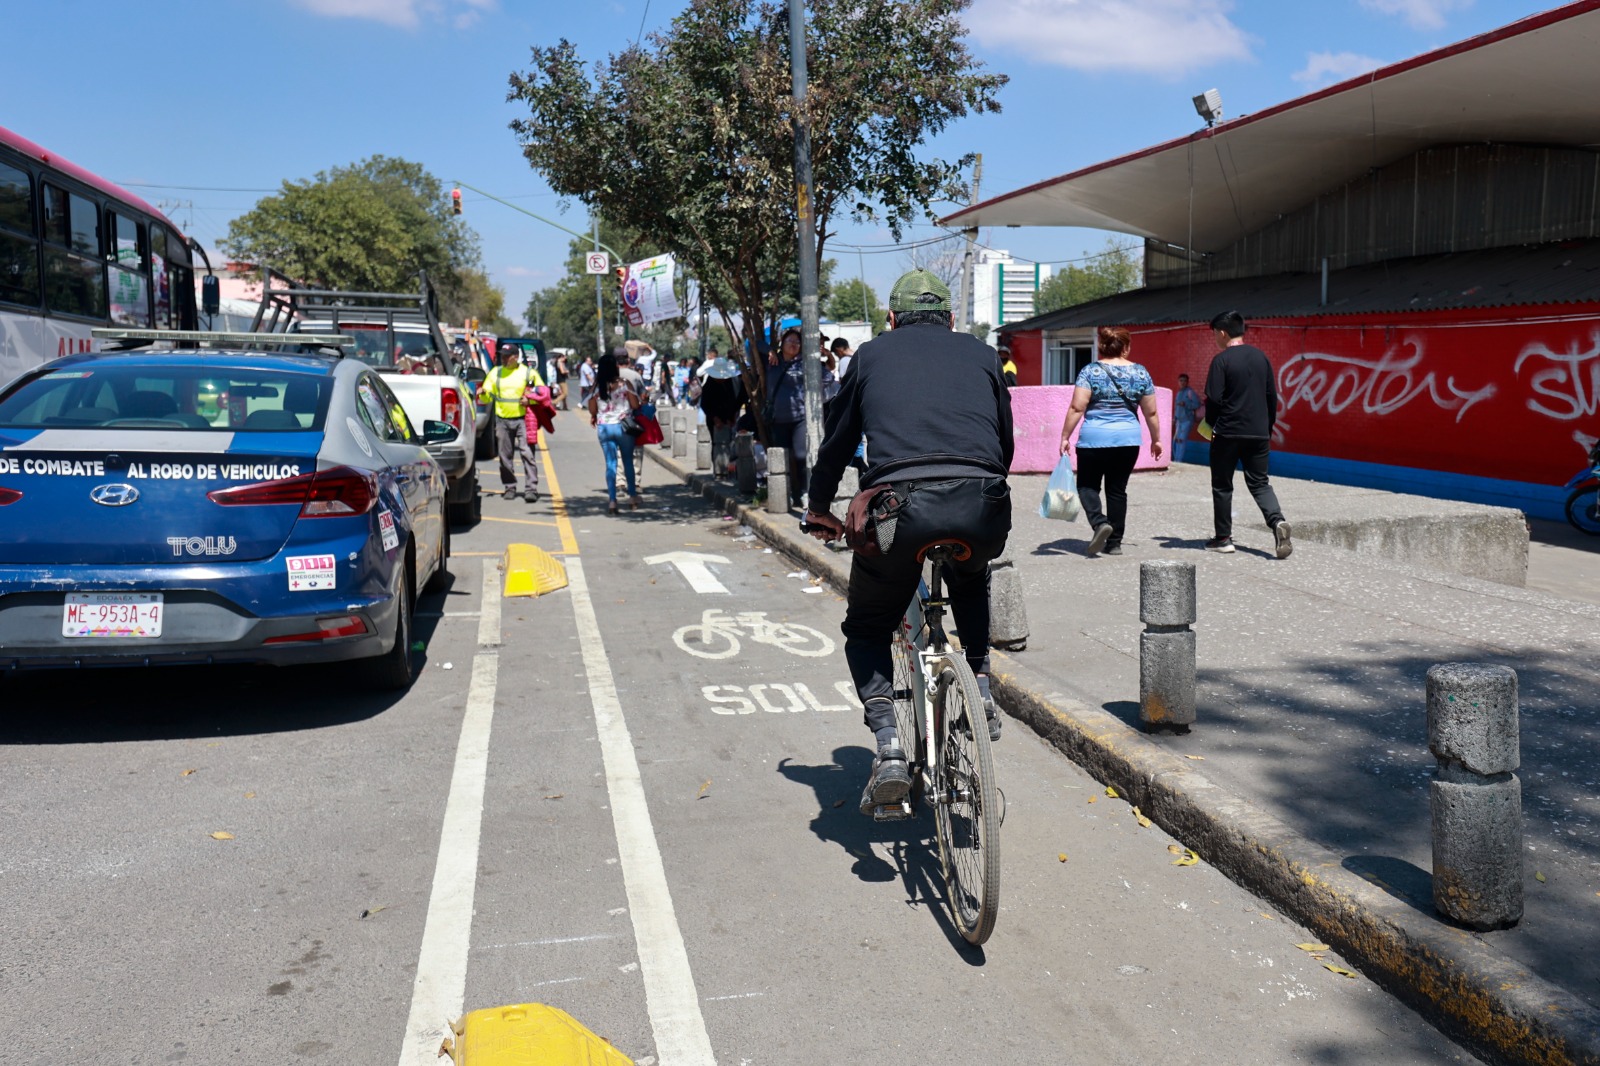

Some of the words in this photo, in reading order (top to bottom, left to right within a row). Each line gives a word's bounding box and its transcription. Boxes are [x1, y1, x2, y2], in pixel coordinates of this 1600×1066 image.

[594, 257, 601, 268] E
[23, 458, 105, 476] COMBATE
[127, 463, 147, 478] AL
[150, 463, 193, 479] ROBO
[197, 464, 217, 480] DE
[220, 464, 300, 480] VEHICULOS
[166, 536, 237, 556] TOLU
[290, 557, 333, 570] 911
[68, 604, 159, 623] ME-953A-4
